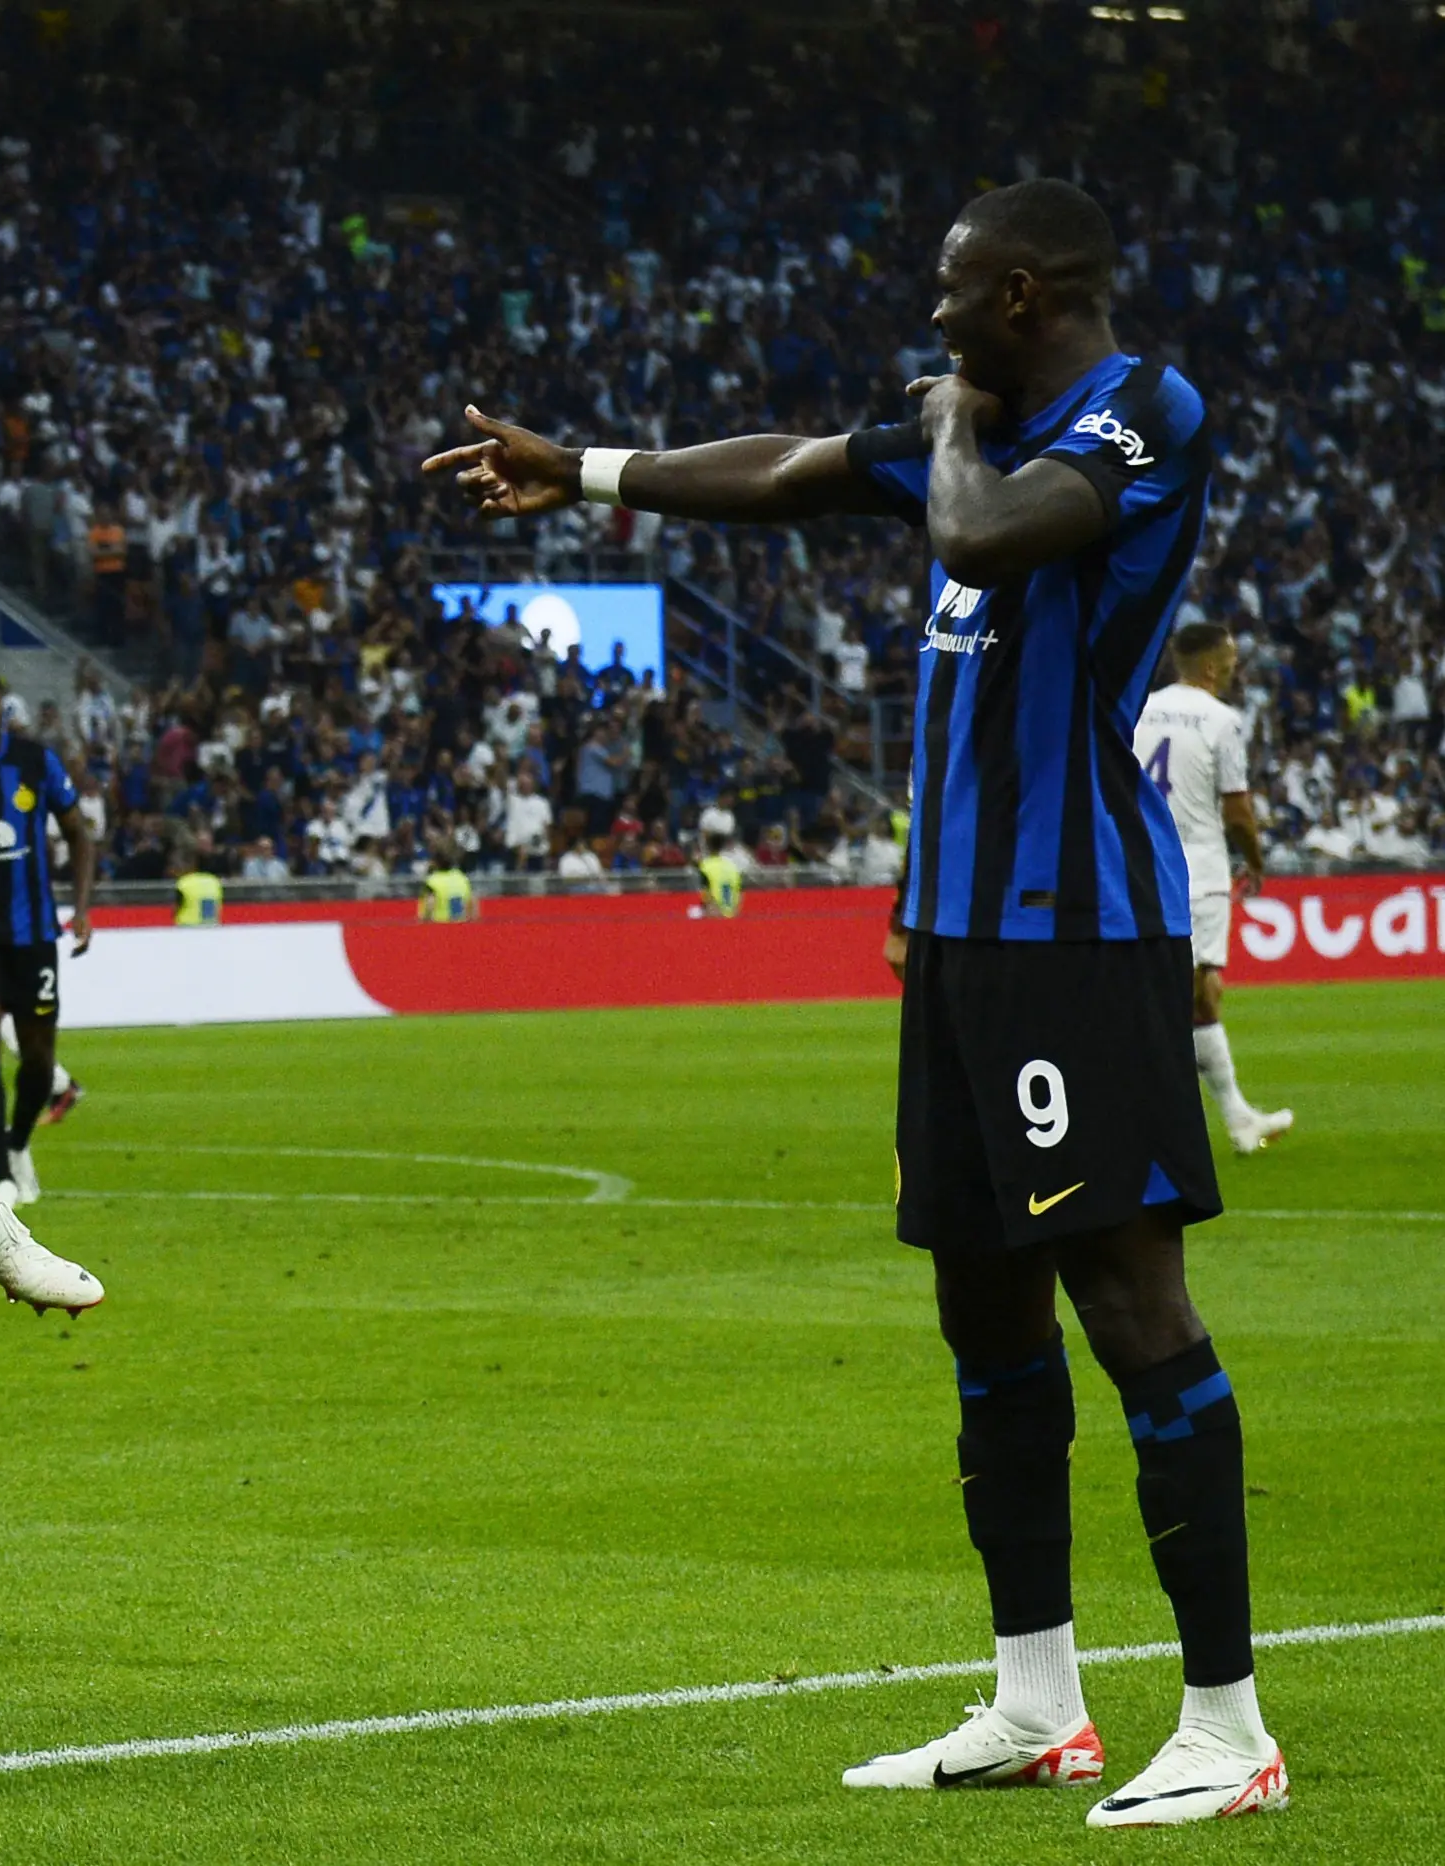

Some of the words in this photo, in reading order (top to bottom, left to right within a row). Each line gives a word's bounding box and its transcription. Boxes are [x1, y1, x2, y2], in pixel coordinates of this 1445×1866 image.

[1074, 409, 1154, 465] ebay
[38, 967, 55, 1000] 2
[1017, 1059, 1069, 1148] 9
